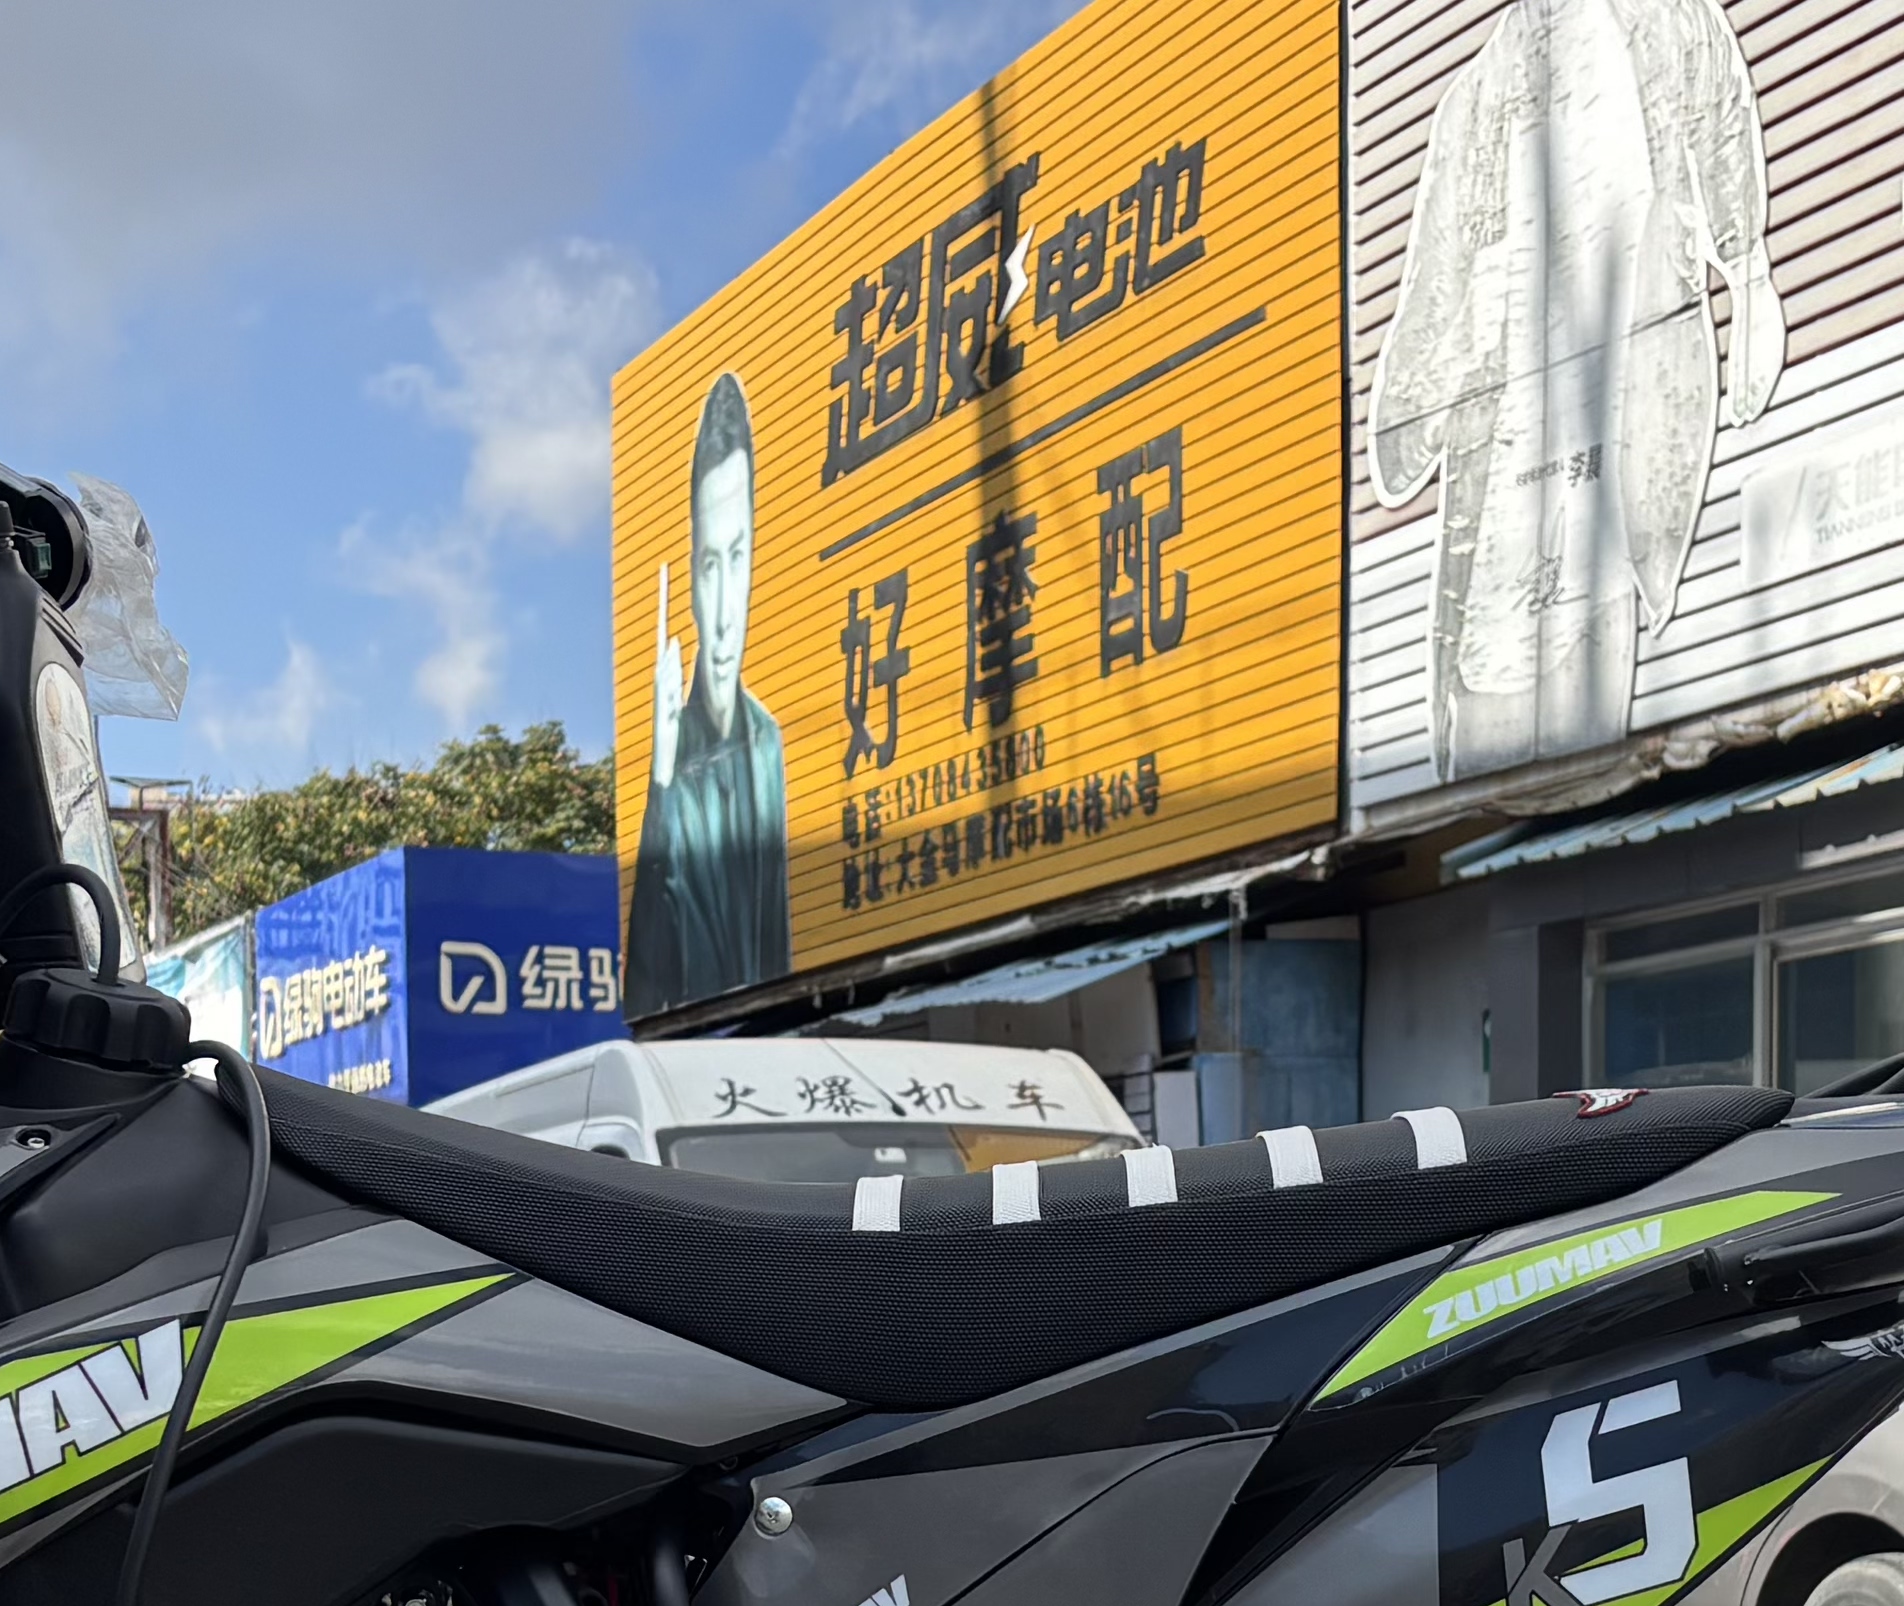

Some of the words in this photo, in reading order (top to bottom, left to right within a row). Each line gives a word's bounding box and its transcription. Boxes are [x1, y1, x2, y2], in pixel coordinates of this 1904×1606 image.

[840, 426, 1189, 778] 好摩配
[712, 1074, 1065, 1122] 火爆机车
[1422, 1218, 1664, 1339] ZUUMAV
